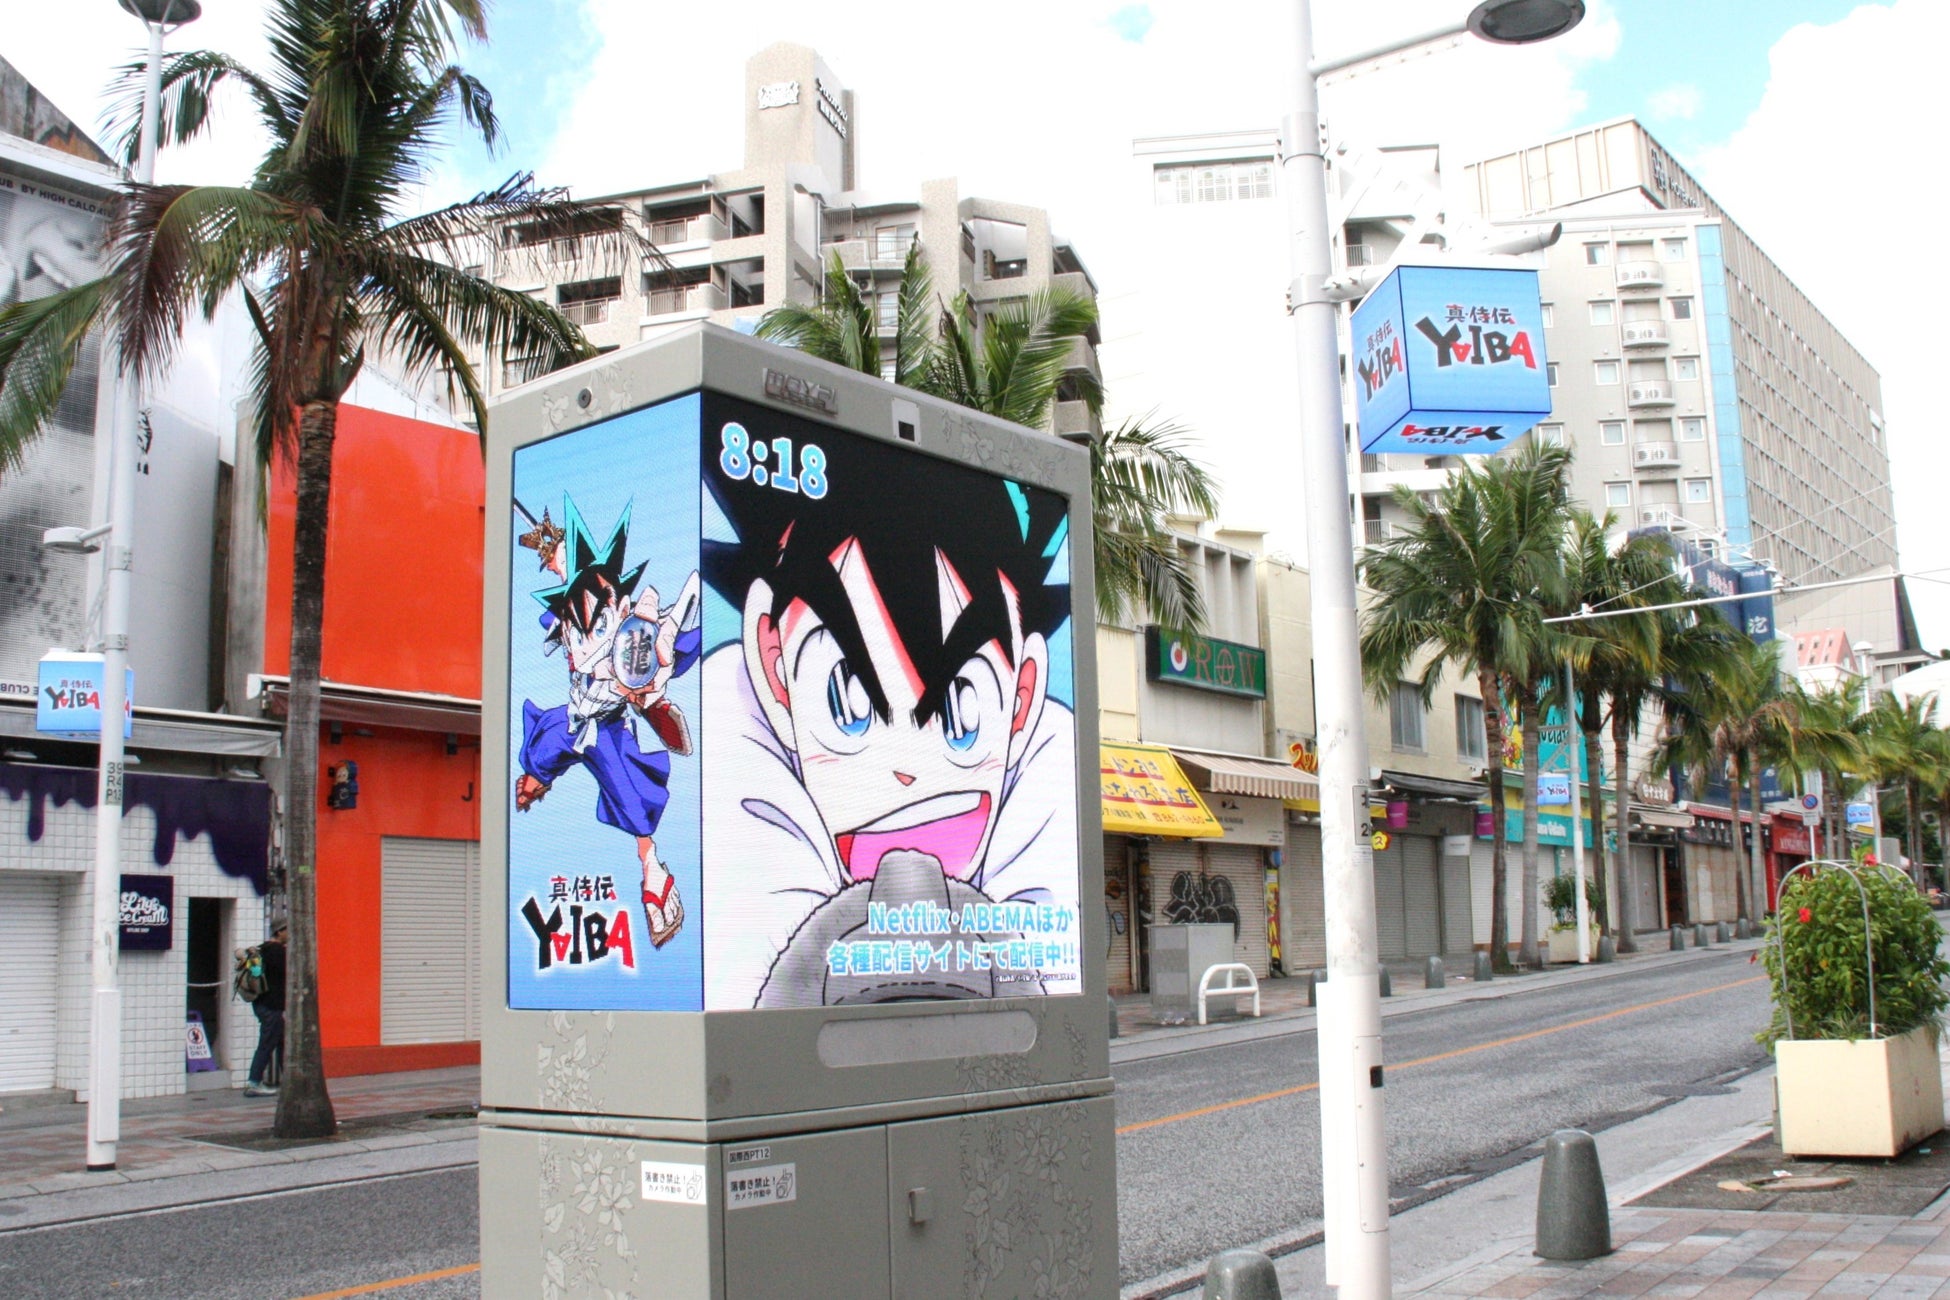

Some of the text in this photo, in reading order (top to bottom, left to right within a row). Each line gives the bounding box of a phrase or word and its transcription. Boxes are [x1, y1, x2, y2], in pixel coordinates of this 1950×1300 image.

[21, 184, 37, 195] BY
[40, 190, 66, 205] HIGH
[1415, 316, 1537, 370] YAIBA
[1358, 336, 1403, 403] YAIBA
[720, 422, 828, 500] 8:18
[44, 686, 101, 710] YAIBA
[521, 896, 635, 970] YAIBA
[827, 939, 1076, 976] 各種配信サイトにて配信中!!
[730, 1176, 776, 1193] 落書き禁止!
